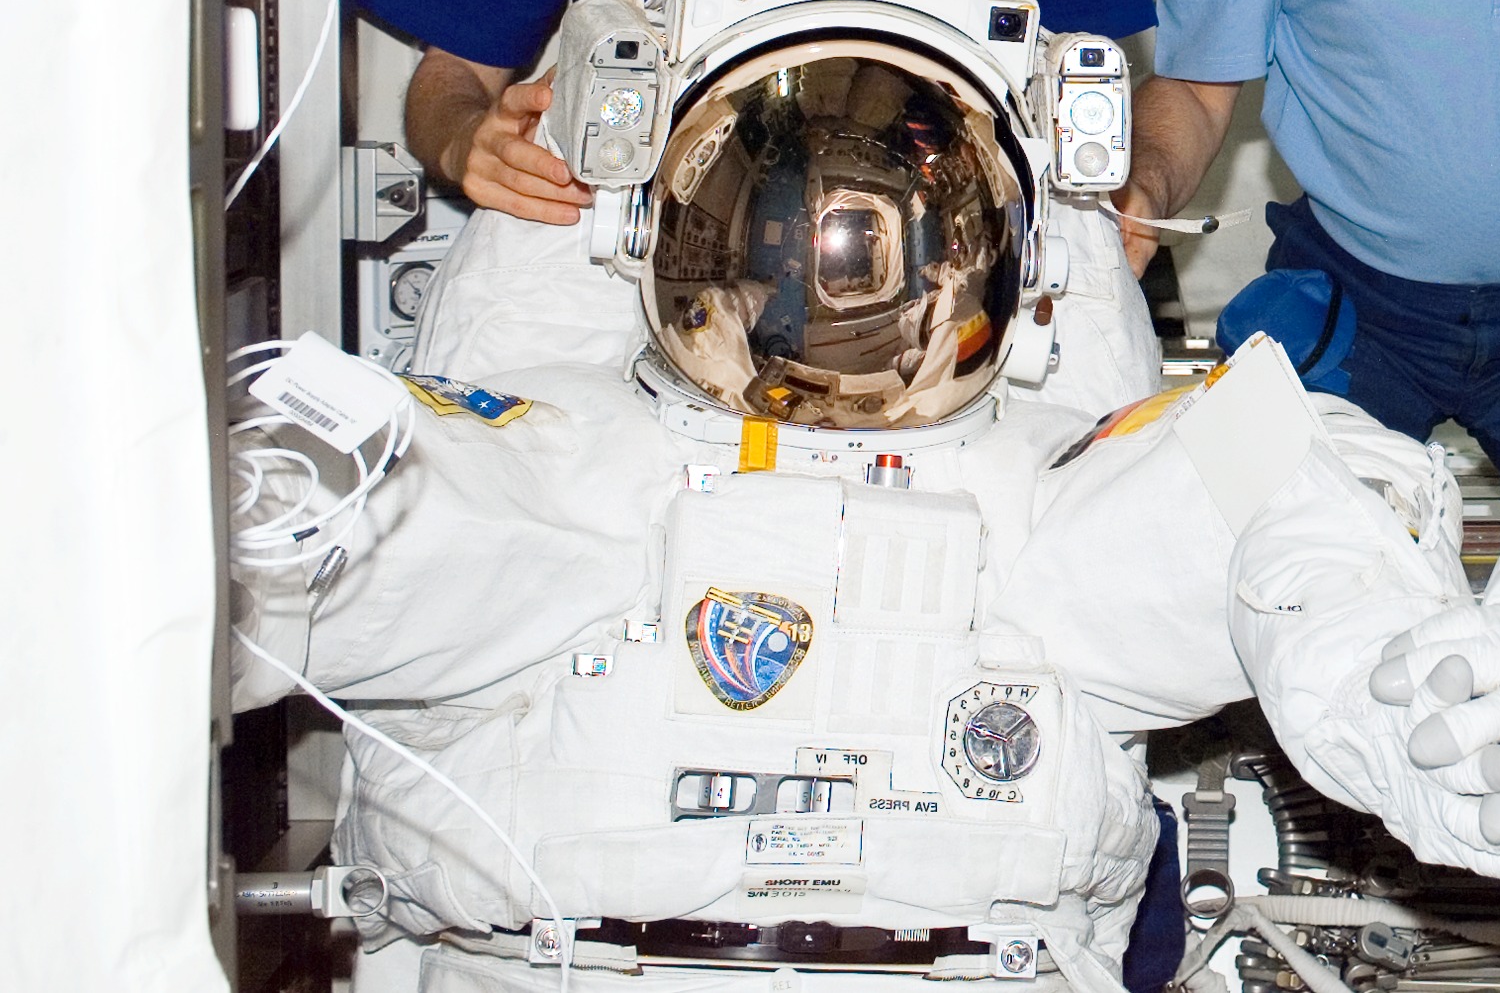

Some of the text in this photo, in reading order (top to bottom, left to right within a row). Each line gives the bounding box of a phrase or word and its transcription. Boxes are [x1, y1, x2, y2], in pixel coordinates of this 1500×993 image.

[789, 622, 811, 643] 13
[689, 641, 715, 686] WILLIAMS
[765, 878, 810, 886] SHORT
[747, 890, 769, 898] S/N
